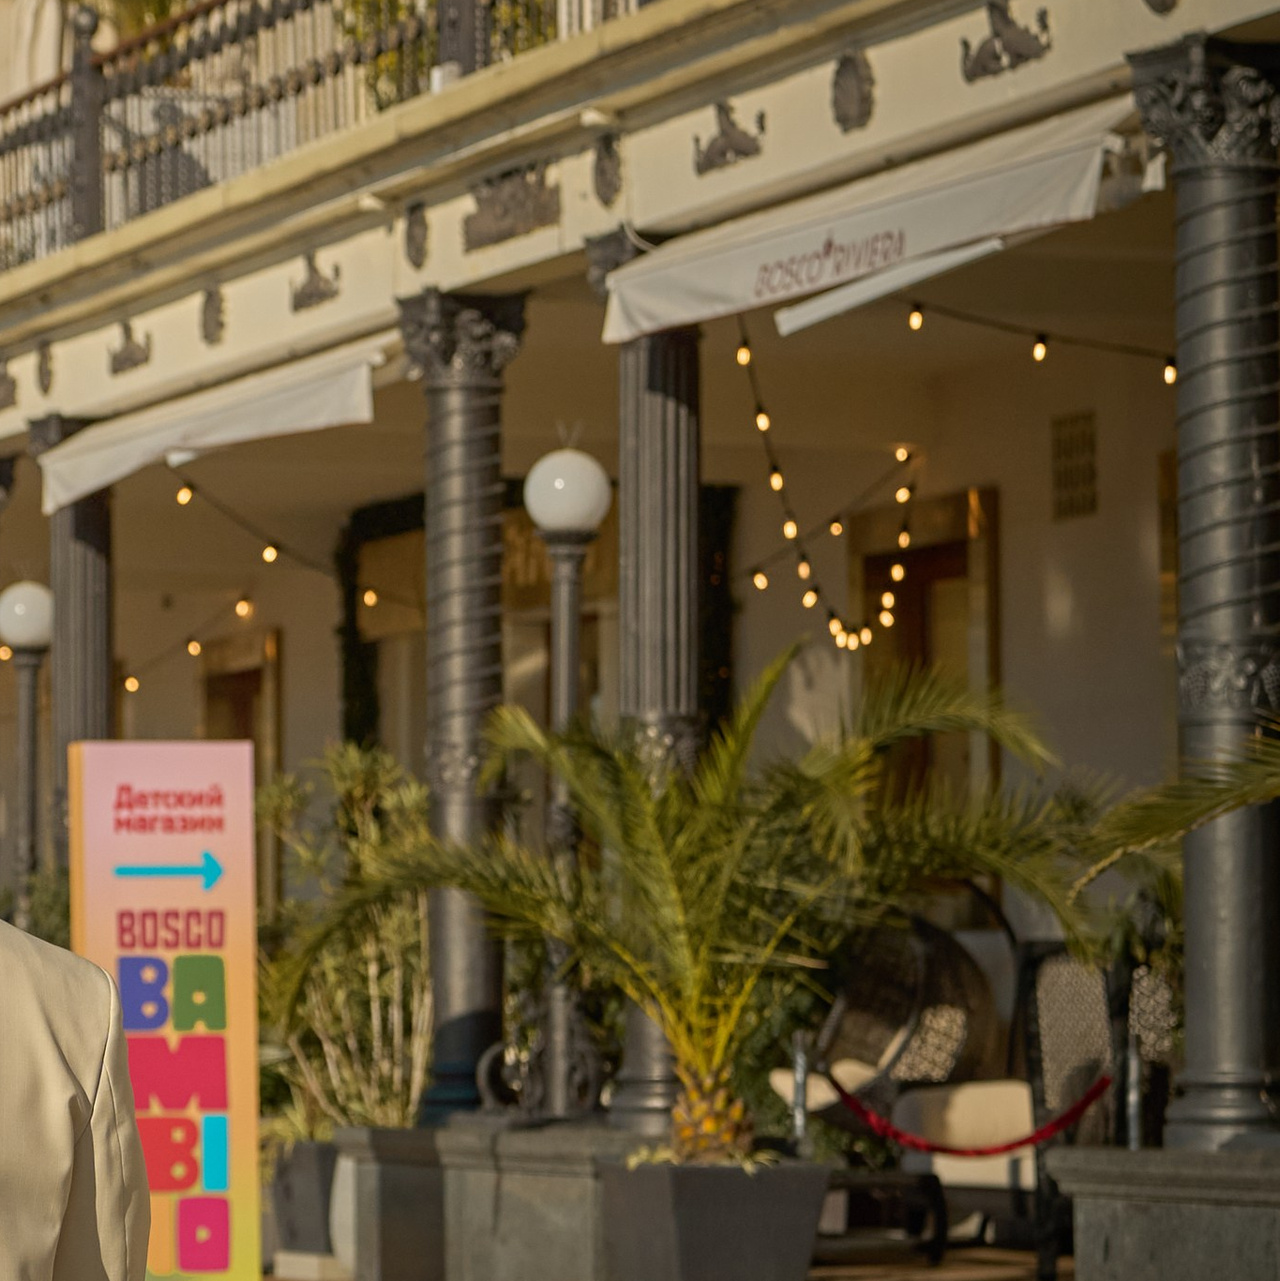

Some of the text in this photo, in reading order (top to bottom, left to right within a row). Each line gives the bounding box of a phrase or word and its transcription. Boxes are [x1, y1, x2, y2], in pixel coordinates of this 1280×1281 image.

[754, 248, 821, 299] BOSCO
[115, 783, 224, 811] Детский
[115, 816, 224, 835] магазин
[117, 909, 225, 951] BOSCO
[117, 955, 227, 1032] BA
